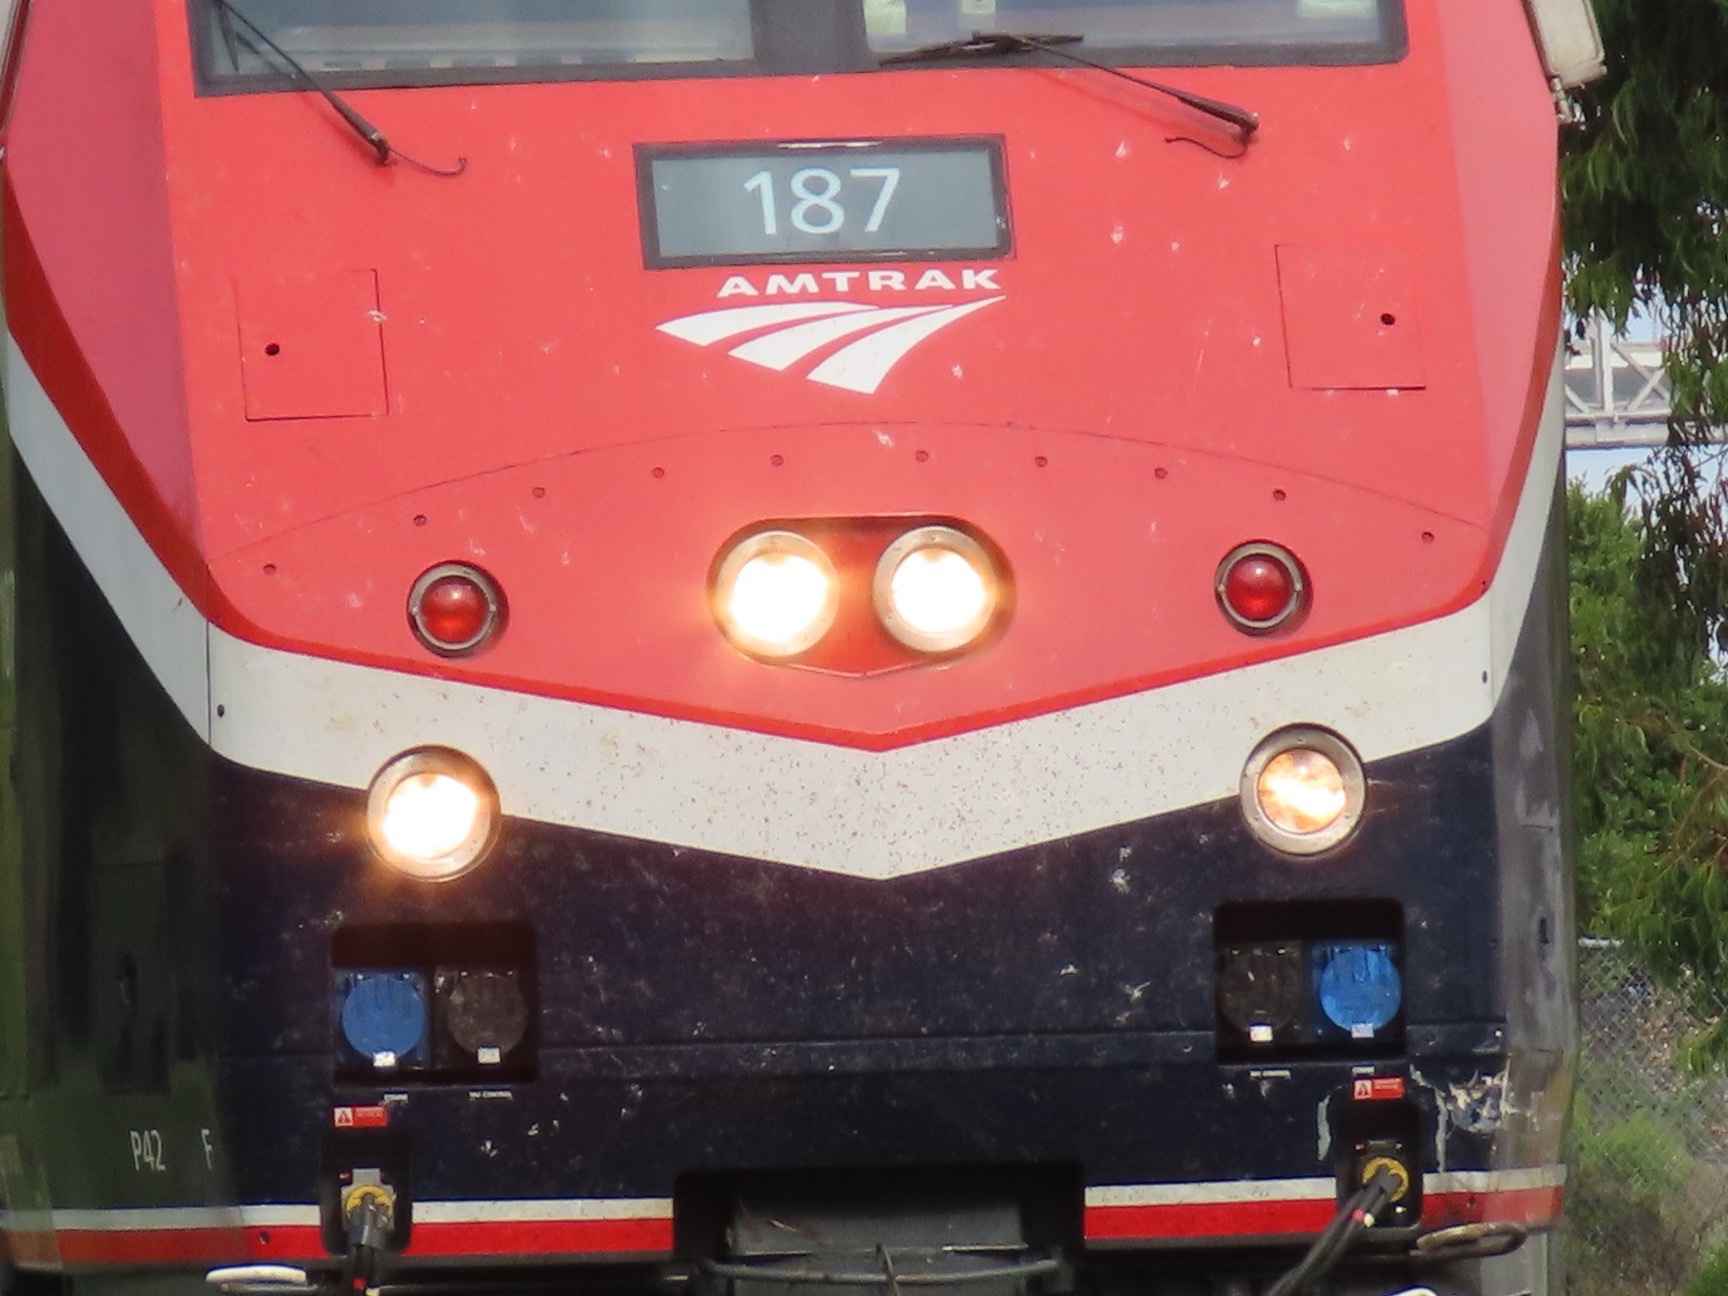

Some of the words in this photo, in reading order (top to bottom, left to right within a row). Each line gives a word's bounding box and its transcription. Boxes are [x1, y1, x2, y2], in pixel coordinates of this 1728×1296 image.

[743, 166, 901, 236] 187
[715, 268, 1003, 299] AMTRAK
[129, 1128, 167, 1172] P42
[200, 1127, 214, 1171] F
